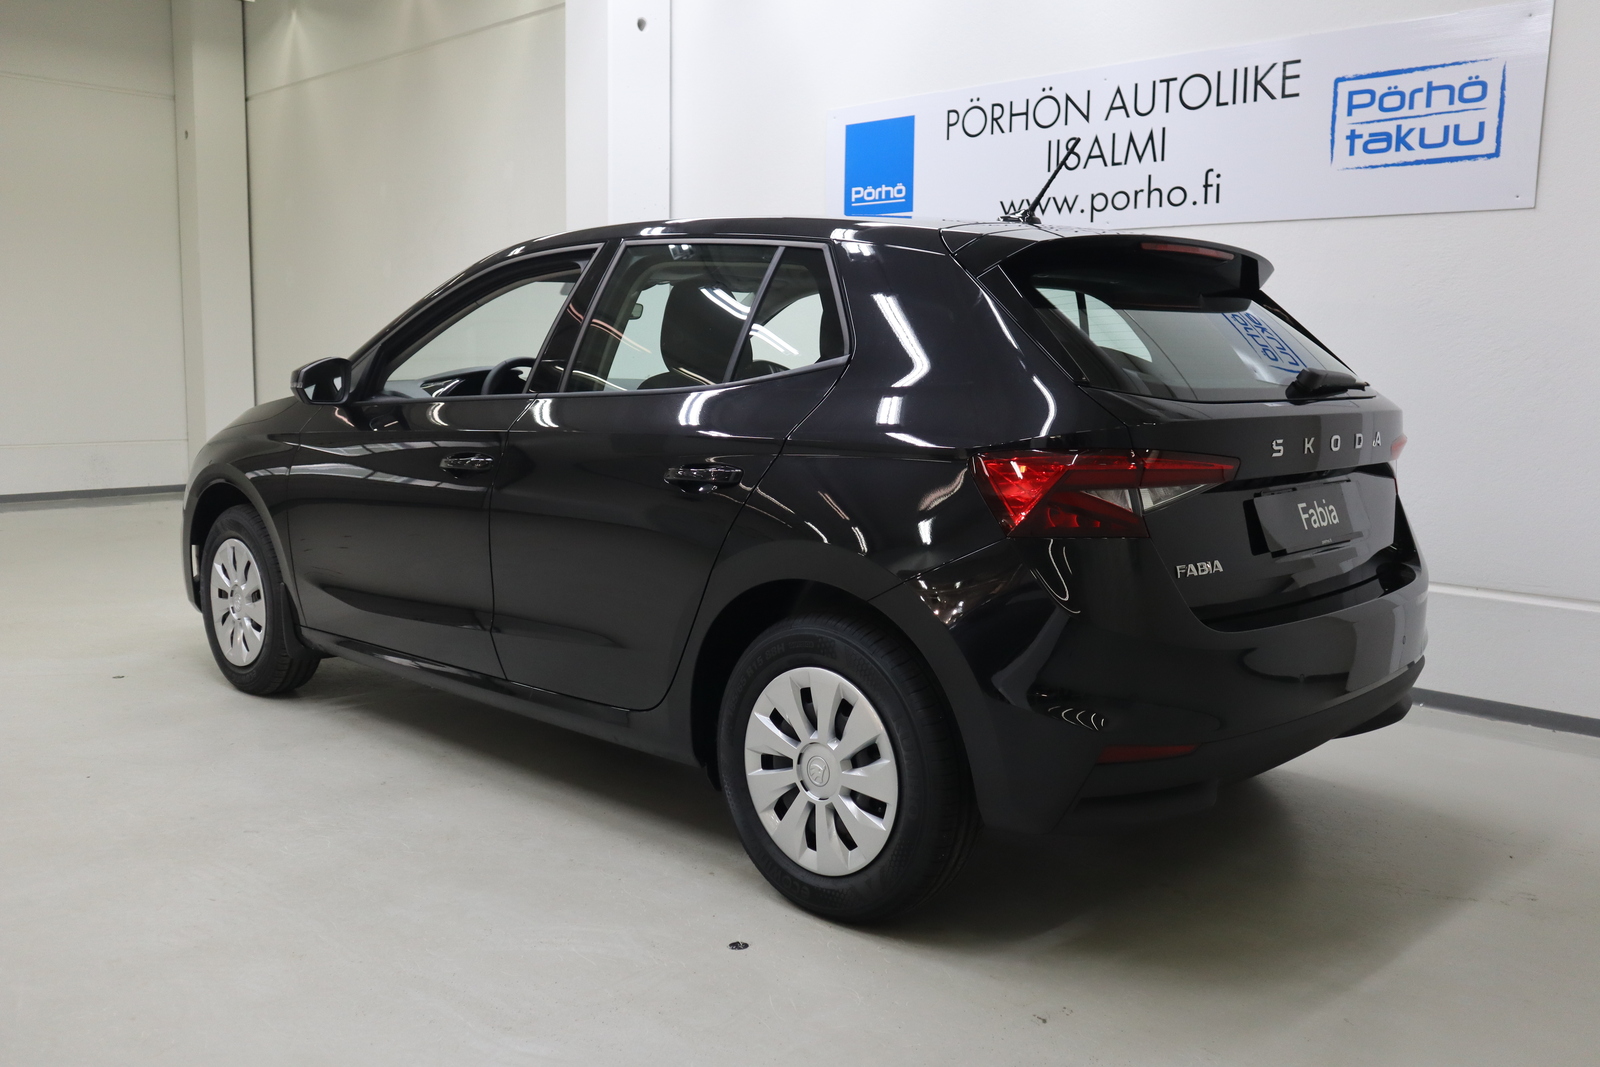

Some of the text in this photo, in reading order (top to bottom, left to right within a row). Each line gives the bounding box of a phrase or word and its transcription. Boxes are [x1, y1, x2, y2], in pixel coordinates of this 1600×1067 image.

[946, 59, 1302, 141] PÖRHÖN AUTOLIIKE
[1346, 73, 1489, 118] Pörhö
[1047, 126, 1166, 173] IISALMI
[1345, 120, 1486, 157] takuu
[851, 182, 906, 203] Pörhö
[1000, 168, 1221, 223] www.porho.fi
[1297, 499, 1340, 531] Fabia
[1175, 559, 1224, 579] FABIA
